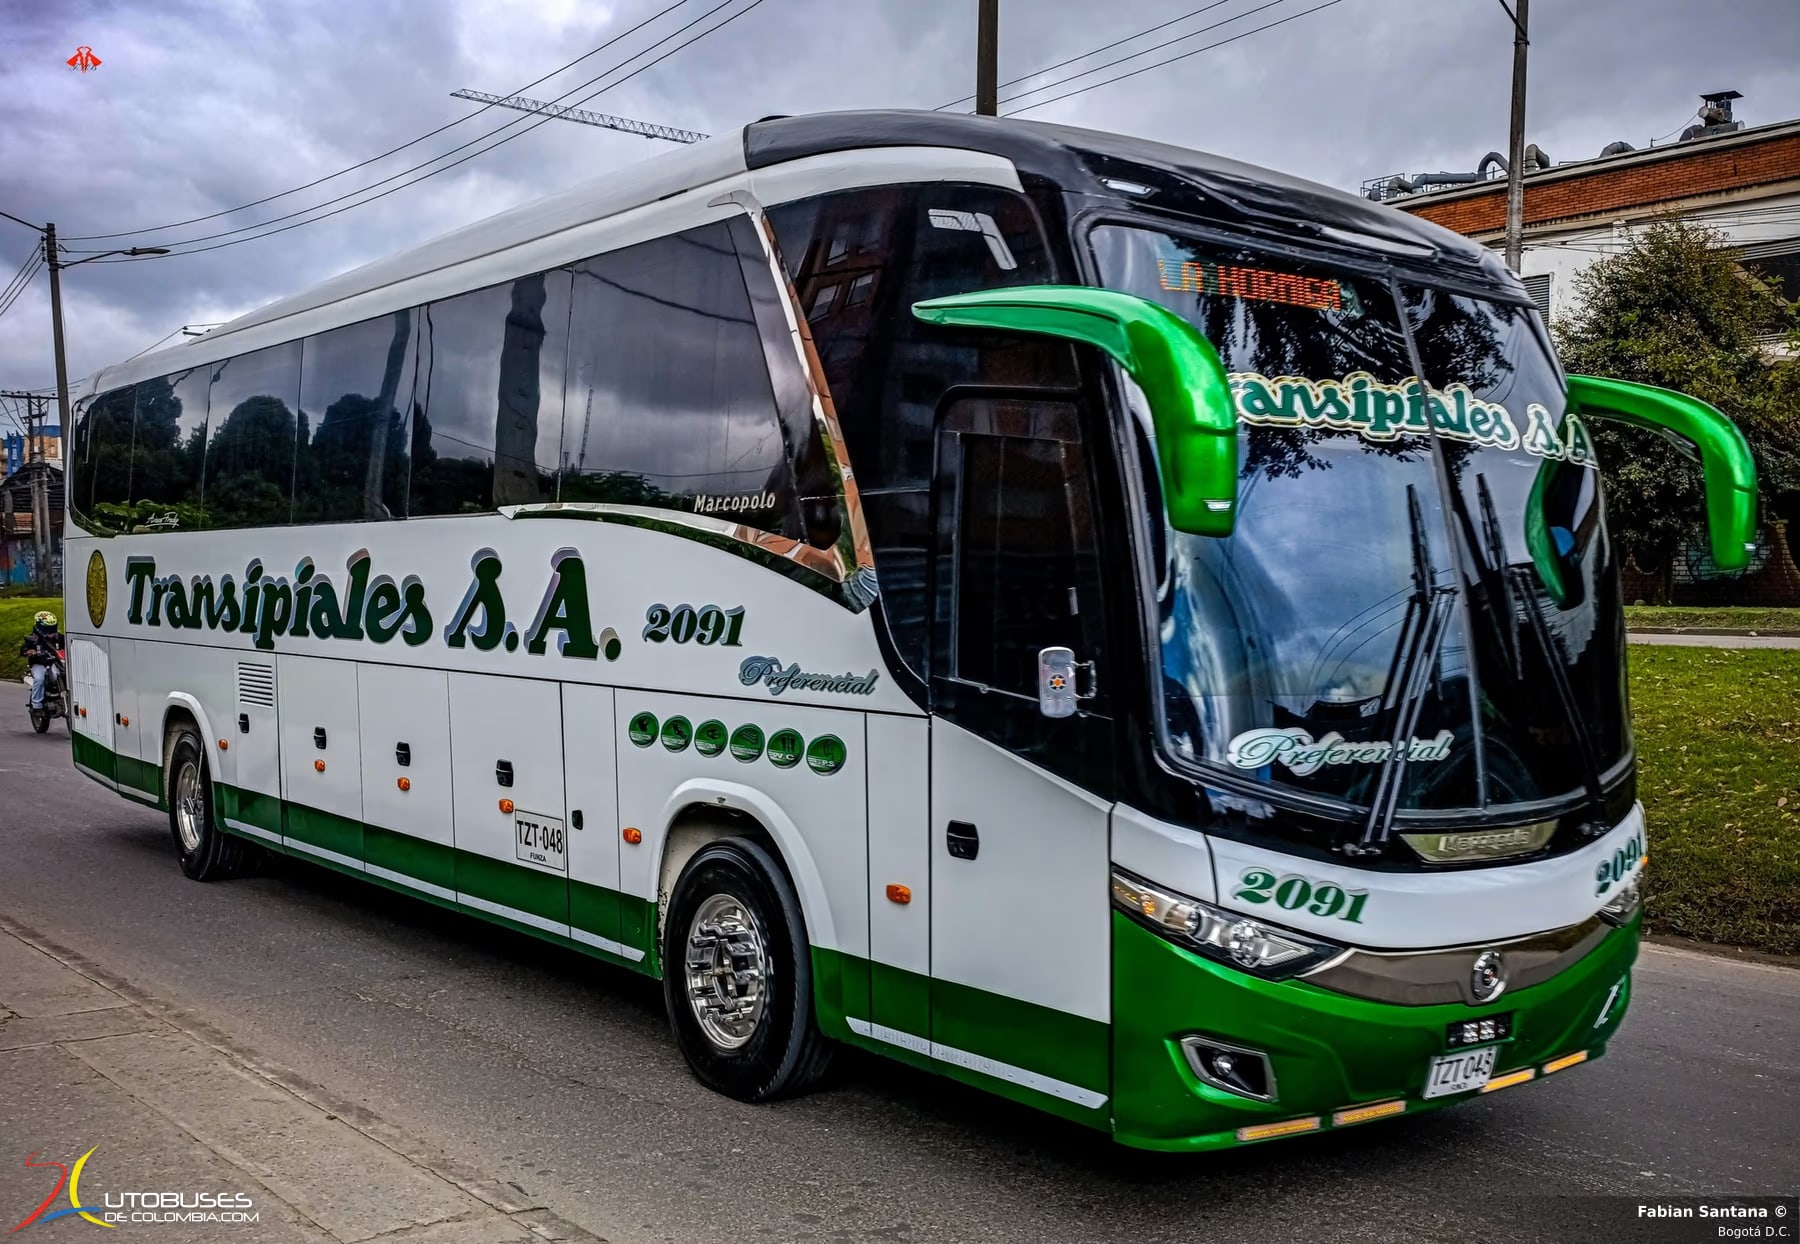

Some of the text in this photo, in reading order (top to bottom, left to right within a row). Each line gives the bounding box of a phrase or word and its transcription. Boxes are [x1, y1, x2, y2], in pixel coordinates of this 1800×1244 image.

[693, 489, 776, 513] Marcopolo
[126, 548, 434, 651] Transipiales
[641, 603, 746, 648] 2091
[738, 655, 880, 697] Preferencial
[529, 852, 547, 863] FUNZA
[1594, 829, 1643, 898] 2091
[1231, 866, 1370, 925] 2091
